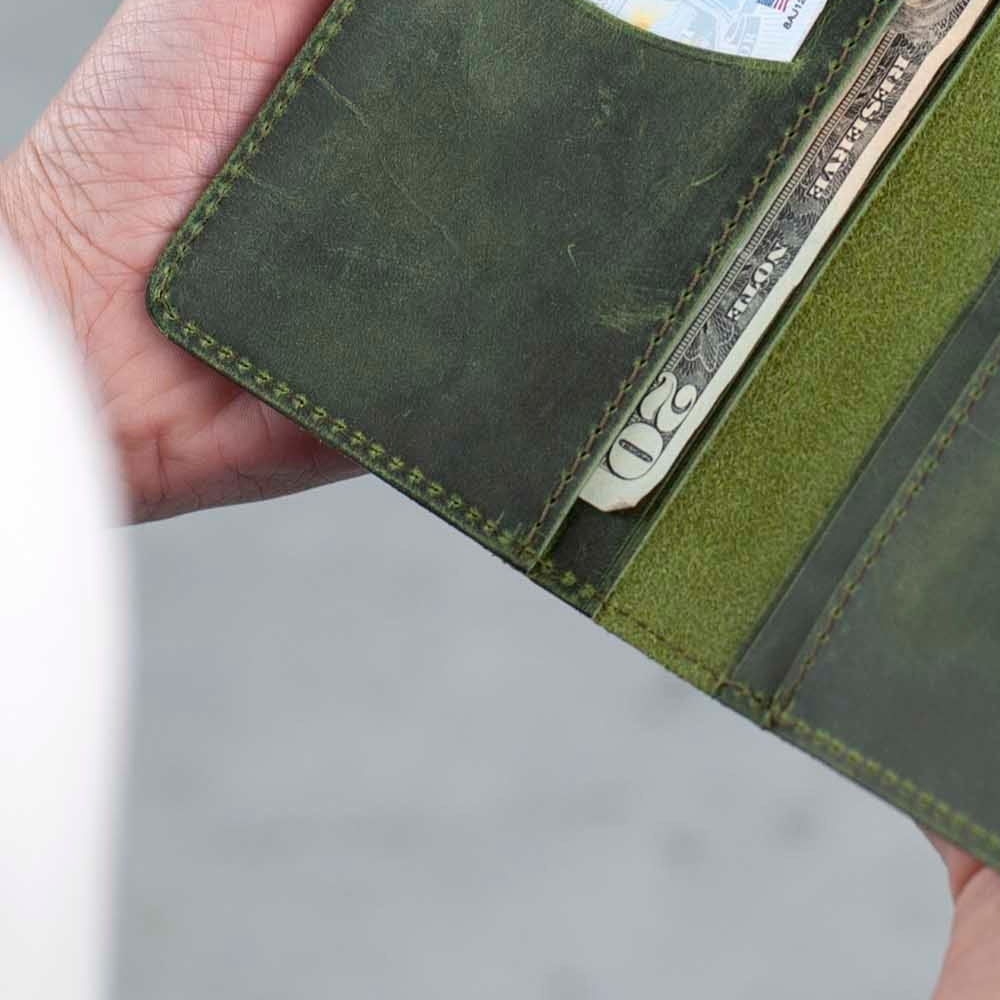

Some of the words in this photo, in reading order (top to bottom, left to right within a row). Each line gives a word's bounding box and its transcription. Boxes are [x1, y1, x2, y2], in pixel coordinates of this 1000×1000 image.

[808, 55, 912, 200] RESERVE
[727, 243, 789, 322] NOTE
[607, 370, 698, 481] 20
